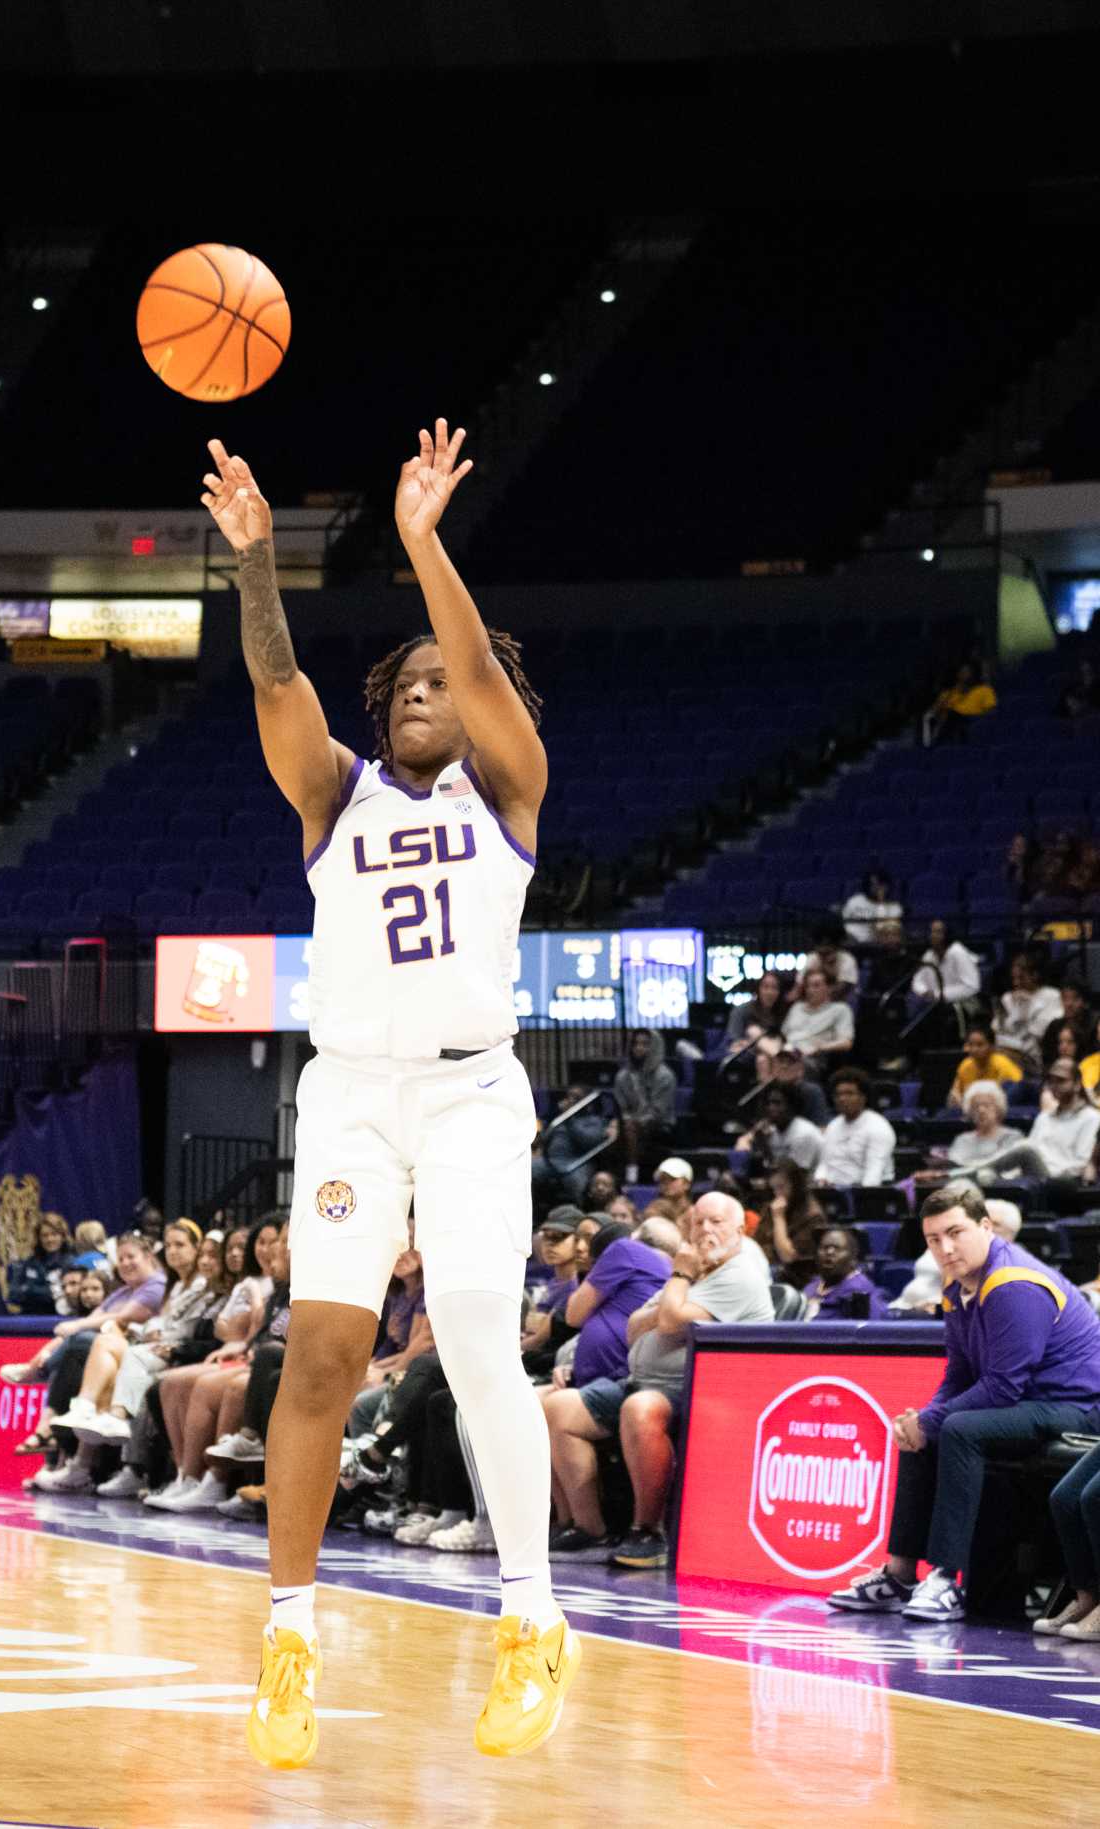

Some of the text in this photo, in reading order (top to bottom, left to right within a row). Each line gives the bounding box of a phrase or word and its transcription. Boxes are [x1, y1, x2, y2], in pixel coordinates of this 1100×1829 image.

[353, 823, 477, 874] LSU
[382, 878, 456, 965] 21
[788, 1421, 858, 1440] FAMILY OWNED
[758, 1436, 882, 1525] Community
[786, 1519, 842, 1542] COFFEE
